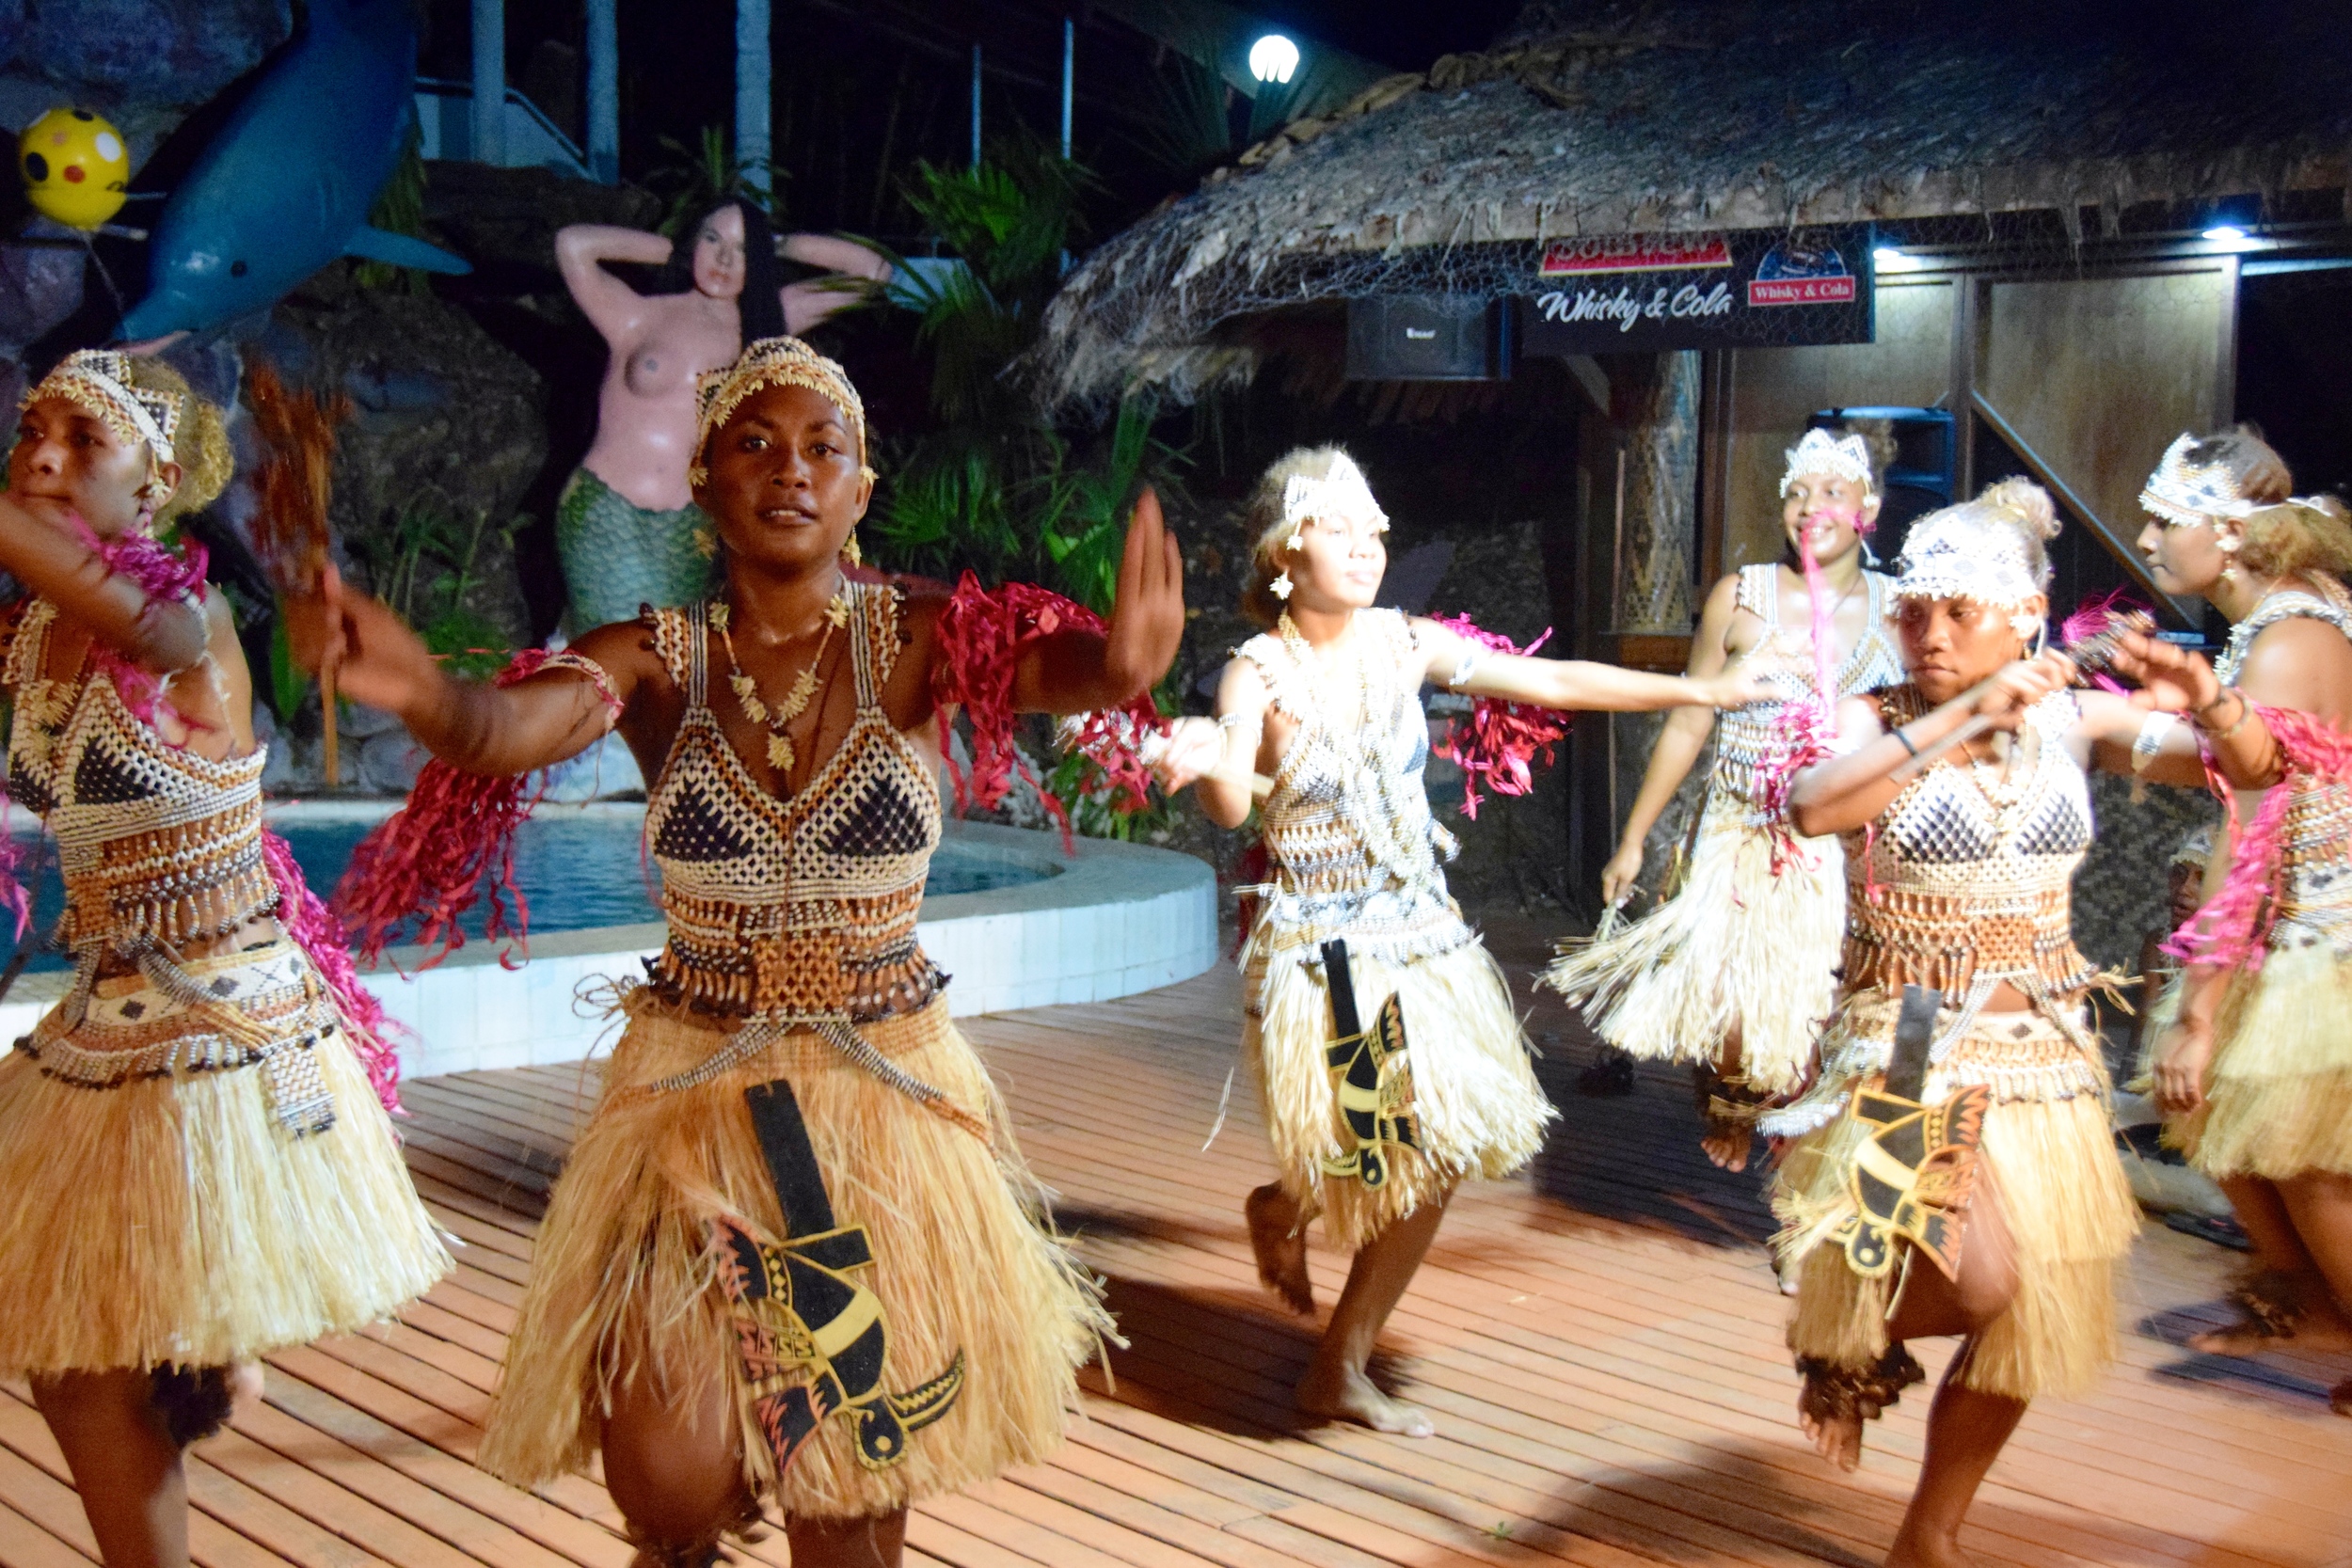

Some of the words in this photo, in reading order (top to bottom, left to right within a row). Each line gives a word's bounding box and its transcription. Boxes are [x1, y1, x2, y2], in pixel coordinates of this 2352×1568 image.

[1536, 288, 1641, 333] Whisky
[1645, 287, 1667, 318] &
[1671, 281, 1733, 318] Cola
[1755, 285, 1800, 300] Whisky
[1804, 284, 1816, 297] &
[1820, 282, 1850, 296] Cola
